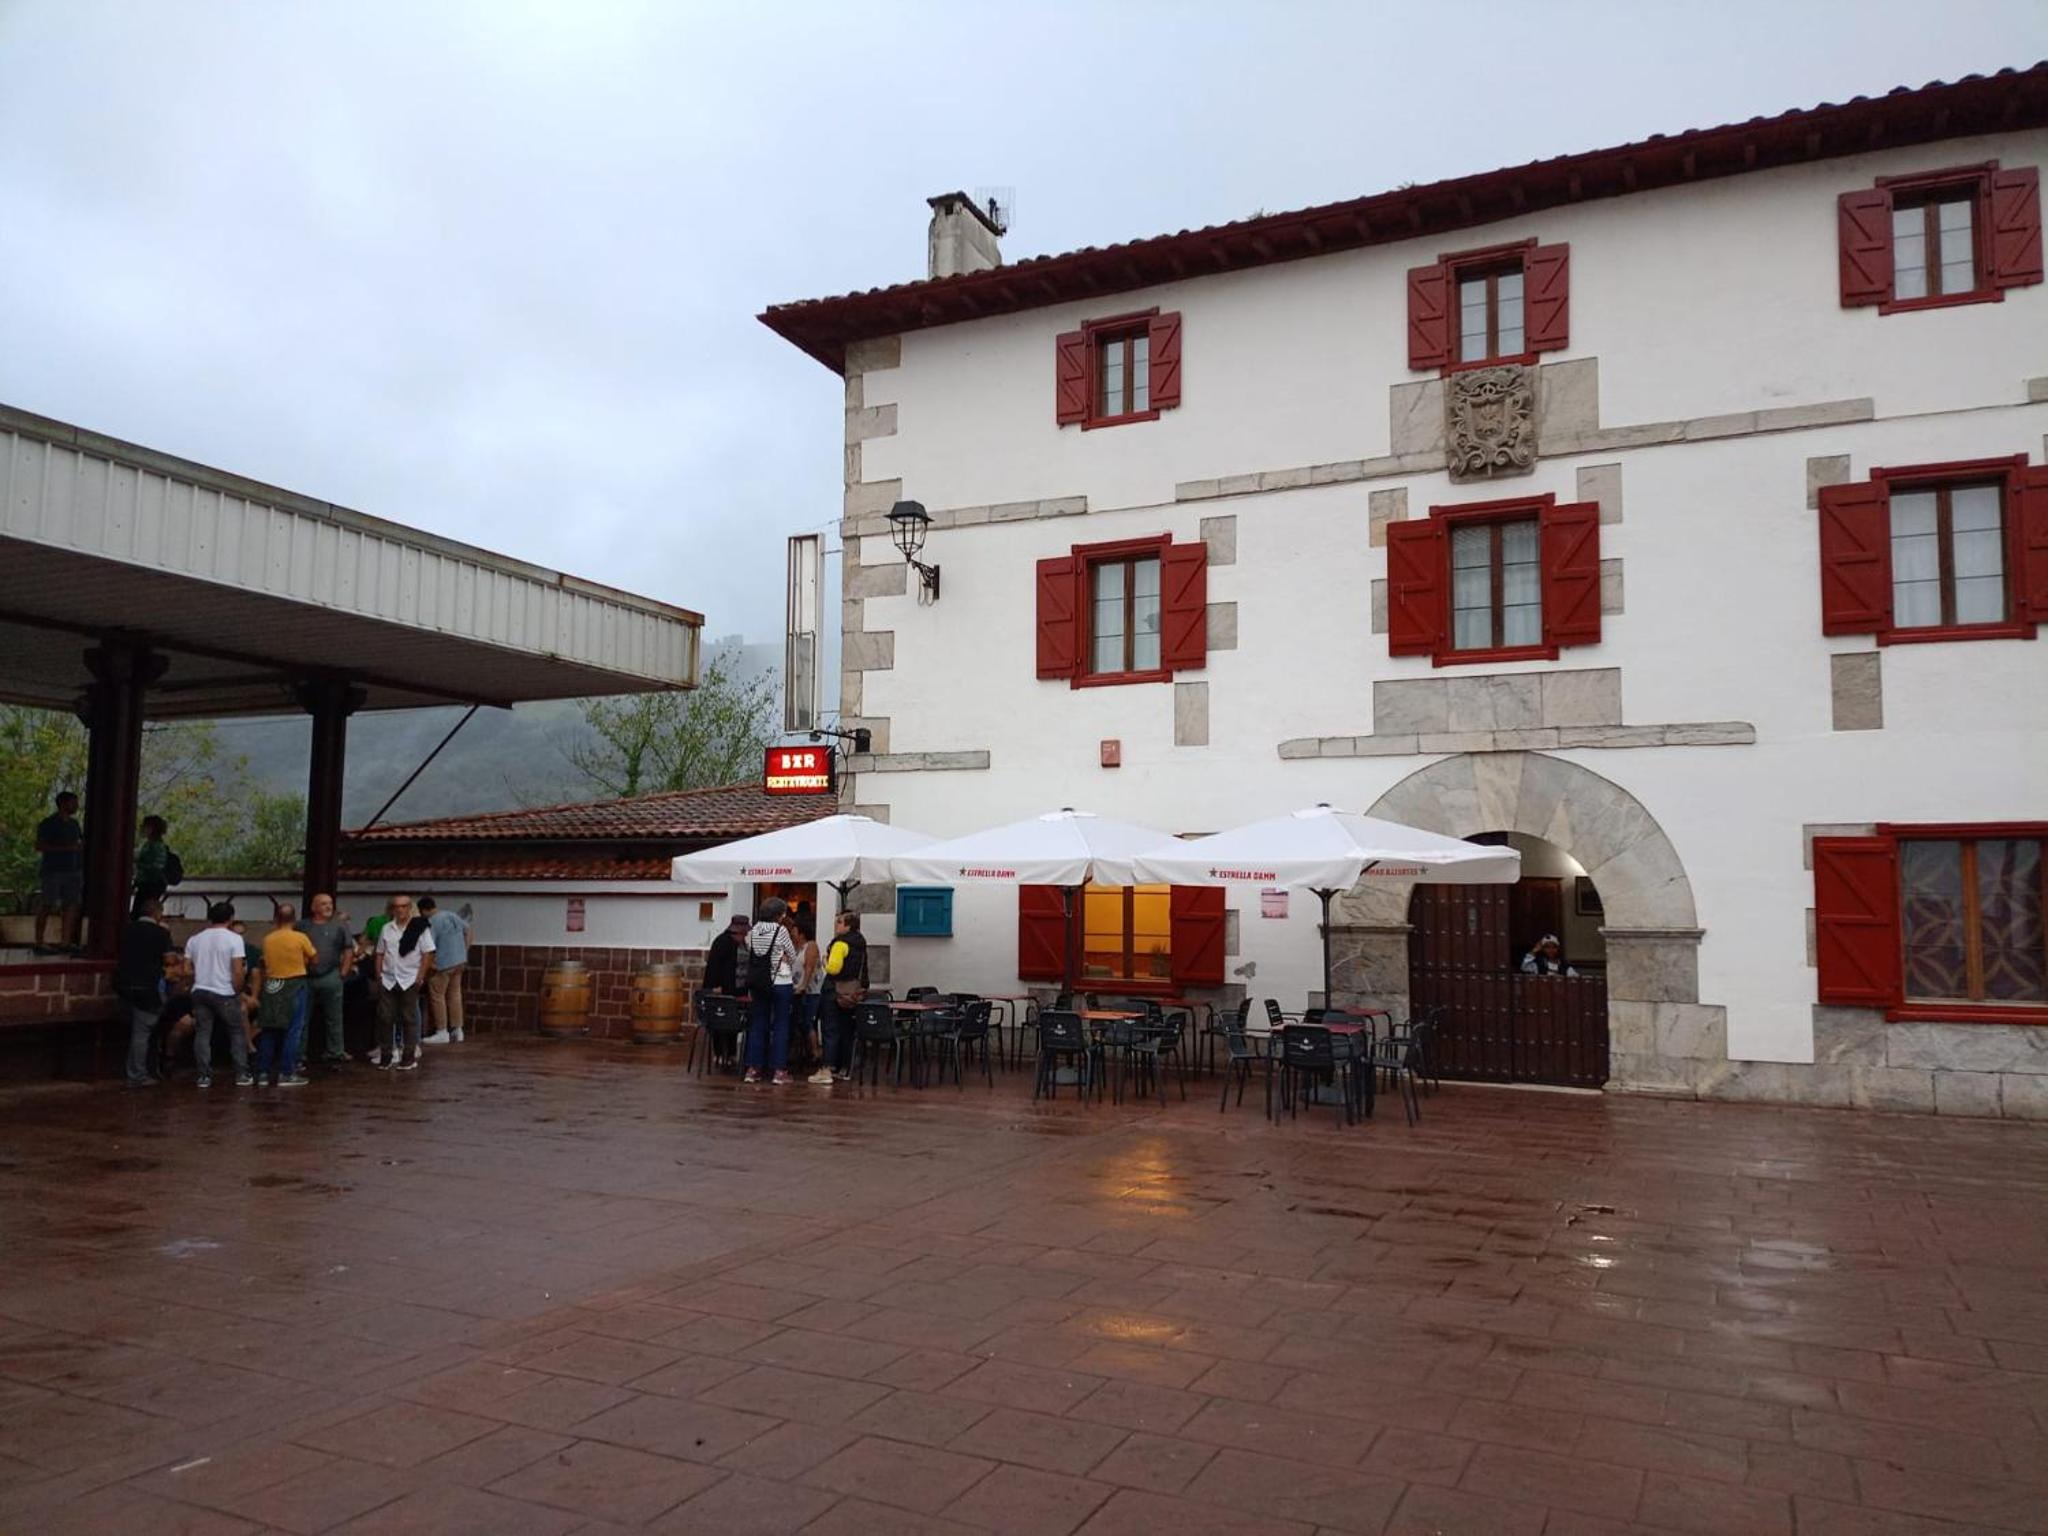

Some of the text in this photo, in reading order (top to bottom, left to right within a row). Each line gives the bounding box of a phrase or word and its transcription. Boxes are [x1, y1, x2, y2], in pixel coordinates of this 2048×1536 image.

[782, 754, 814, 770] BAR
[1219, 870, 1276, 881] ESTRELLA DAMM
